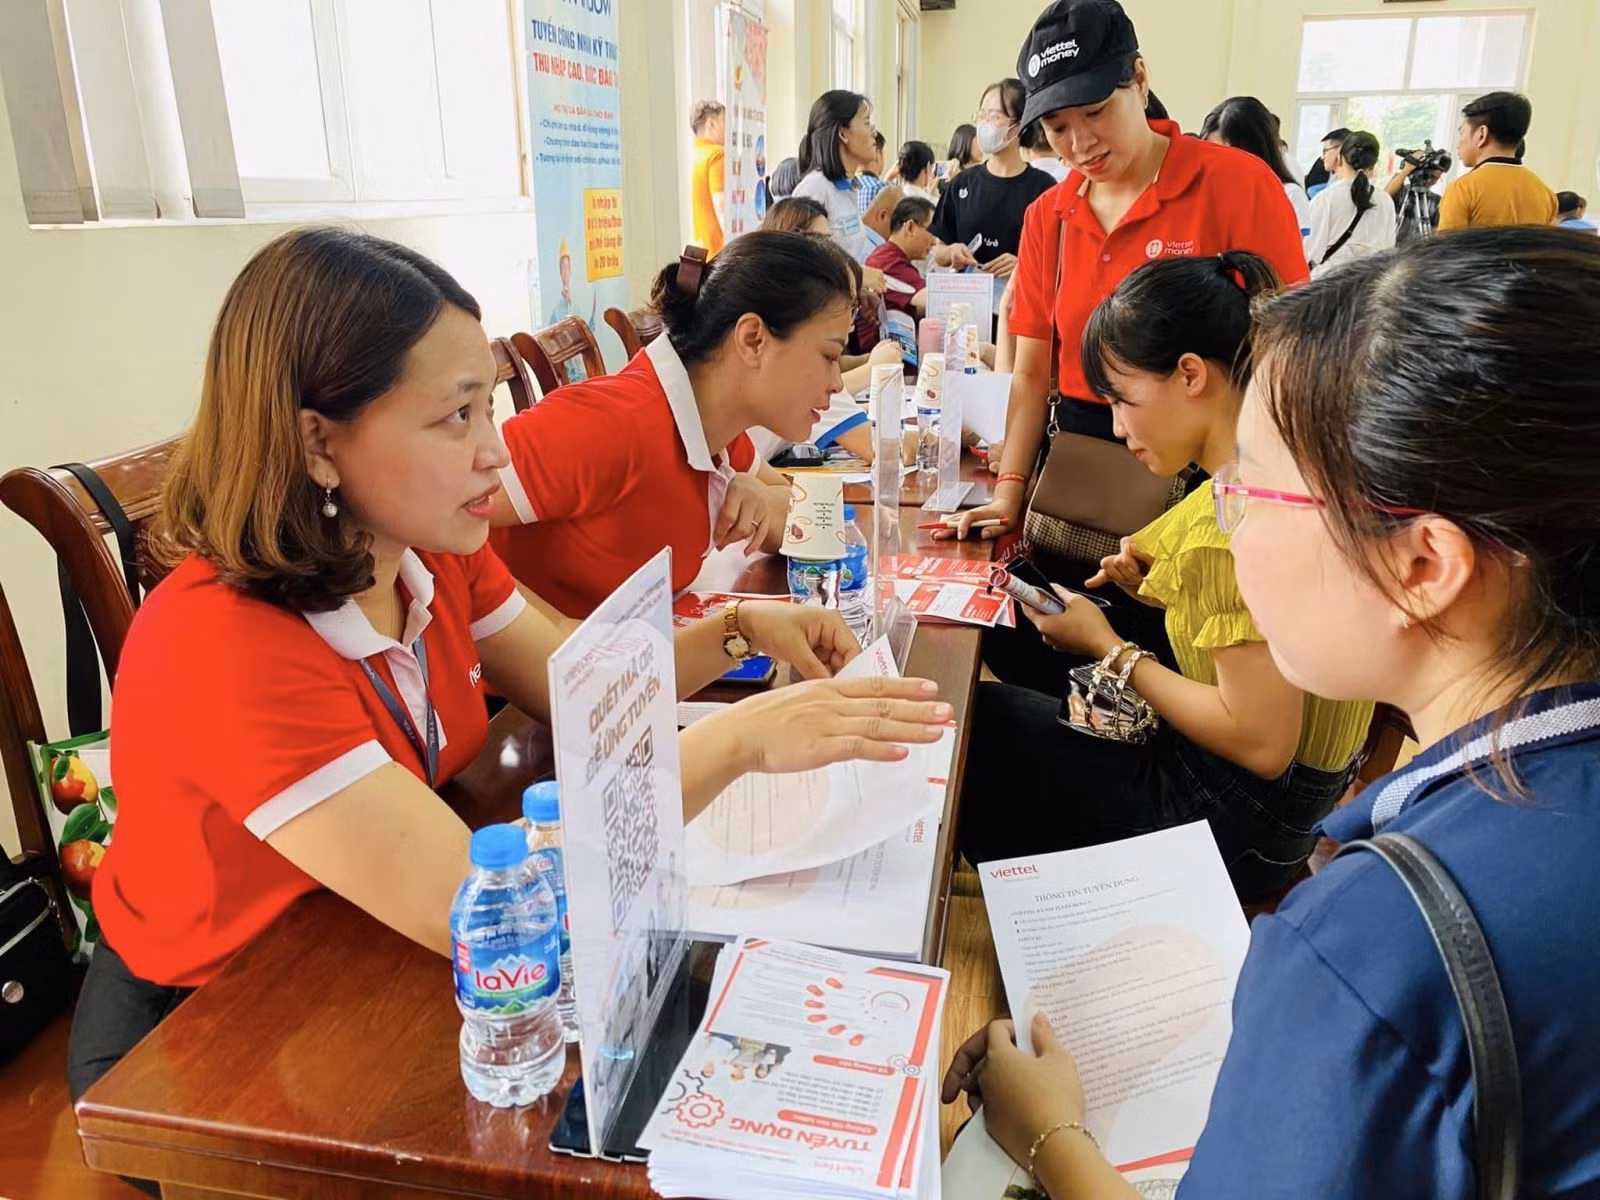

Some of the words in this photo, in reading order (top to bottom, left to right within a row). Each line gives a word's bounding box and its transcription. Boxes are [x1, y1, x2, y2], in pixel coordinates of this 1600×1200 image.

[1040, 39, 1078, 58] viettel
[1040, 47, 1080, 68] money
[533, 52, 550, 74] THU
[589, 682, 620, 735] QUÉT
[990, 864, 1039, 878] viettel
[1034, 892, 1065, 902] THÔNG
[1067, 889, 1082, 898] TIN
[475, 963, 545, 991] laVie
[729, 1117, 793, 1139] DỤNG
[798, 1131, 873, 1152] TUYỂN
